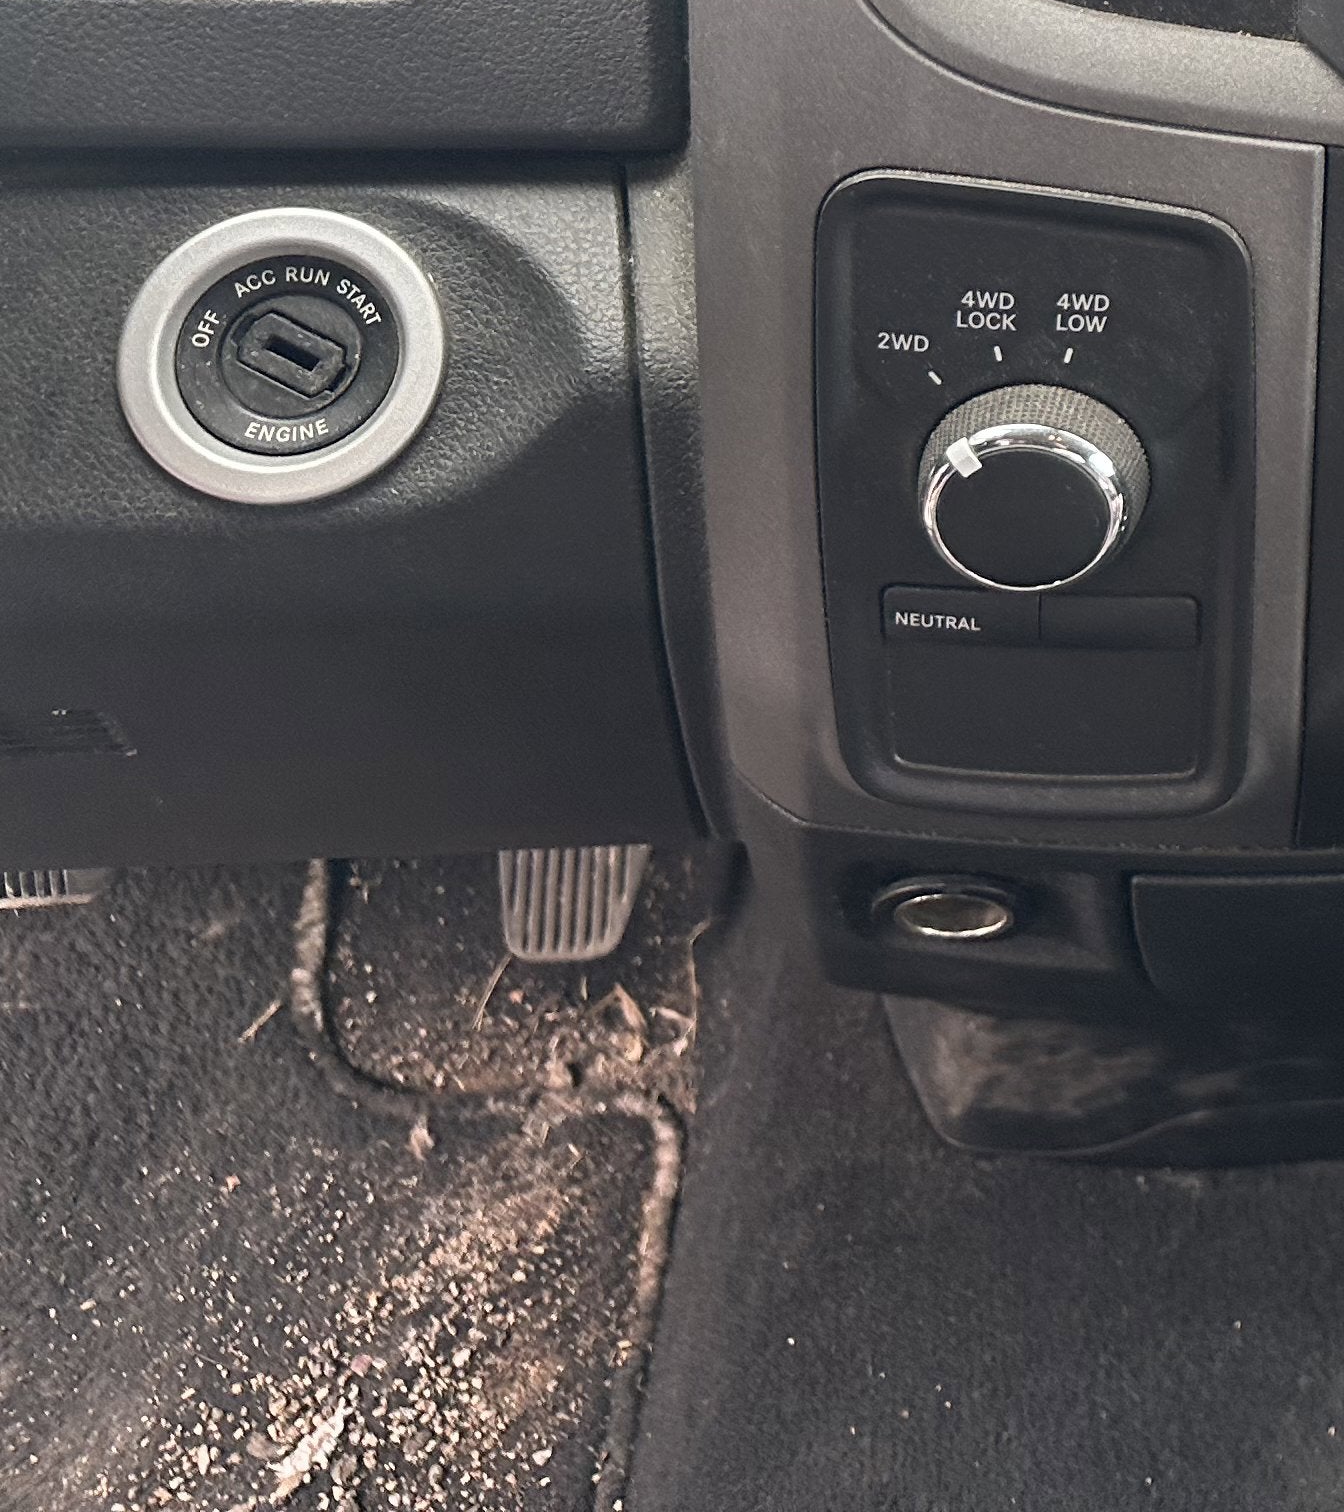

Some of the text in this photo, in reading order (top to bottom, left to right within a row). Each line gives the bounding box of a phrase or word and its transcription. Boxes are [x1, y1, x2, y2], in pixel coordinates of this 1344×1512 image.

[191, 266, 382, 348] OFF ACC RUN START
[961, 290, 1015, 310] 4WD
[1057, 293, 1110, 313] 4WD
[956, 311, 1017, 332] LOCK
[1055, 313, 1108, 333] LOW
[877, 332, 929, 353] 2WD
[244, 417, 330, 443] ENGINE
[895, 611, 981, 632] NEUTRAL
